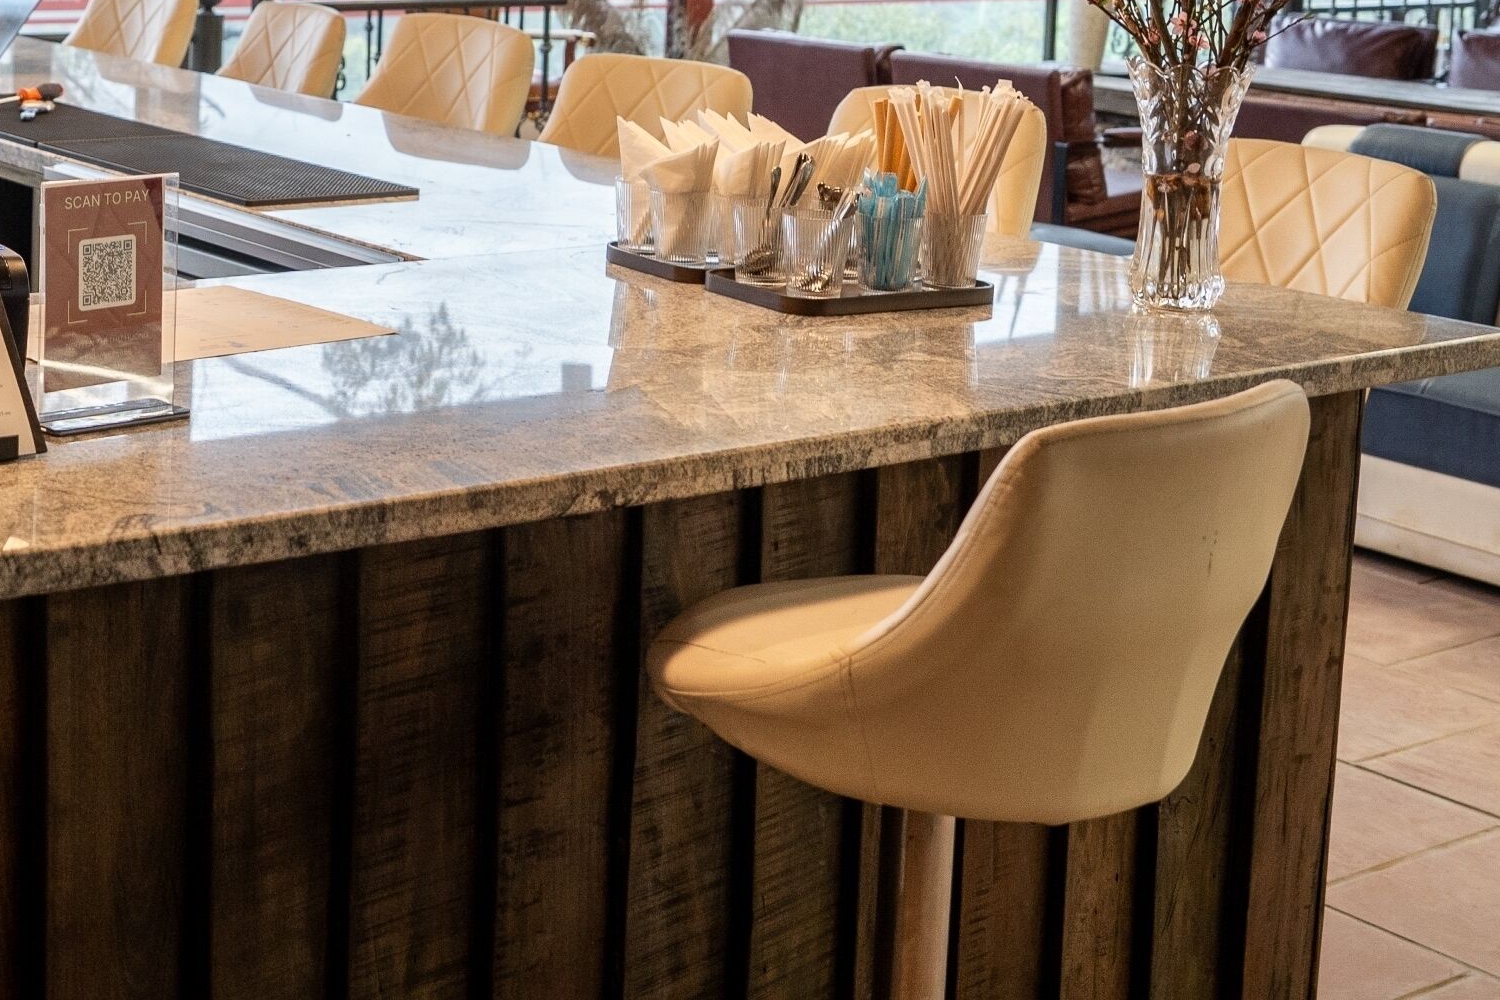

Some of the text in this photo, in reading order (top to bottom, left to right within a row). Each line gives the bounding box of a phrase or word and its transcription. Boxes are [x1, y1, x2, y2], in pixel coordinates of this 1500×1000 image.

[64, 189, 150, 210] SCAN TO PAY
